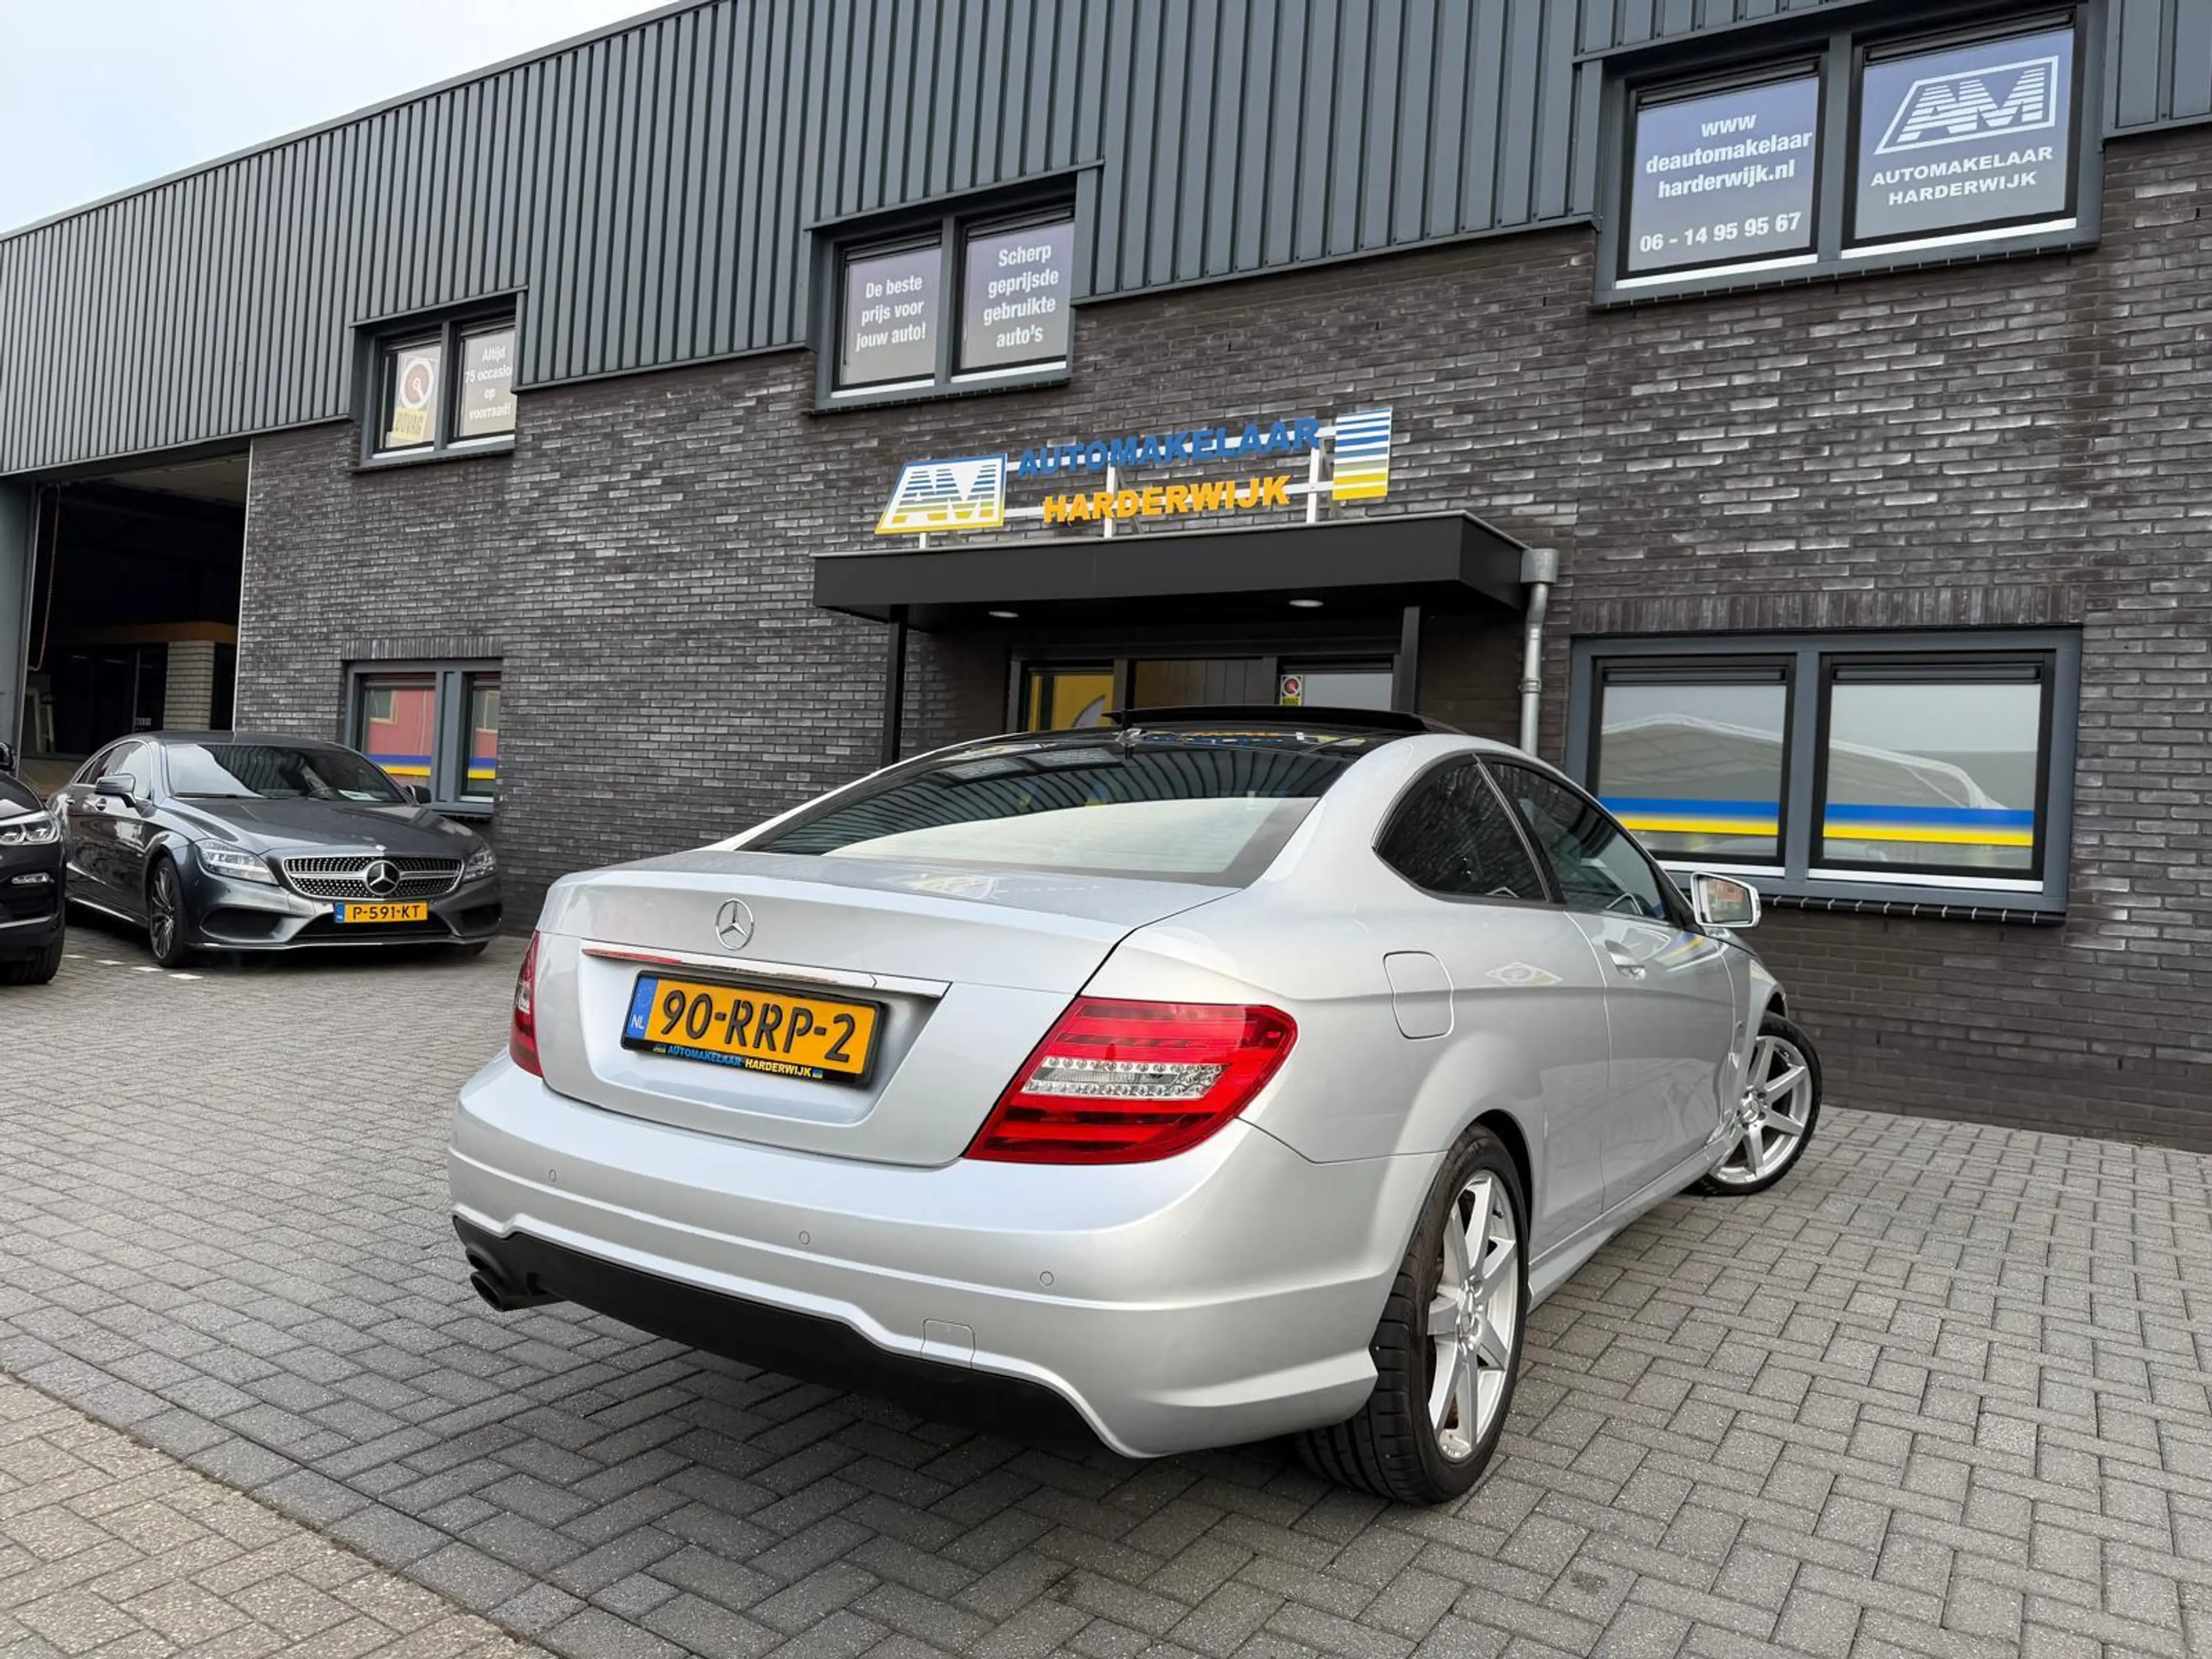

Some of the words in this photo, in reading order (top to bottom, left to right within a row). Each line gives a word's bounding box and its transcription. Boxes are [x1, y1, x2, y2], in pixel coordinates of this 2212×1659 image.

[1701, 115, 1758, 138] www
[1646, 131, 1813, 174] deautomakelaar
[1870, 146, 2053, 187] AUTOMAKELAAR
[1658, 159, 1796, 198] harderwijk.nl
[1888, 171, 2038, 206] HARDERWIJK
[1639, 233, 1664, 252] 06
[1684, 226, 1707, 246] 14
[1713, 222, 1738, 241] 95
[1744, 217, 1769, 237] 95
[1775, 211, 1801, 232] 67
[998, 244, 1052, 267] Scherp
[865, 281, 883, 299] De
[885, 275, 923, 296] beste
[988, 268, 1059, 298] geprijsde
[861, 305, 891, 326] prijs
[894, 301, 924, 318] voor
[983, 296, 1056, 325] gebruikte
[855, 330, 889, 352] jouw
[891, 321, 926, 342] auto!
[996, 324, 1043, 348] auto's
[484, 388, 495, 402] op
[1016, 416, 1321, 478] AUTOMAKELAAR
[1043, 475, 1289, 522] HARDERWIJK
[353, 905, 420, 920] P-591-KT
[631, 1015, 645, 1029] NL
[660, 989, 855, 1063] 90-RRP-2
[667, 1044, 743, 1066] AUTOMAKELAAR
[745, 1059, 812, 1077] HARDERWIJK
